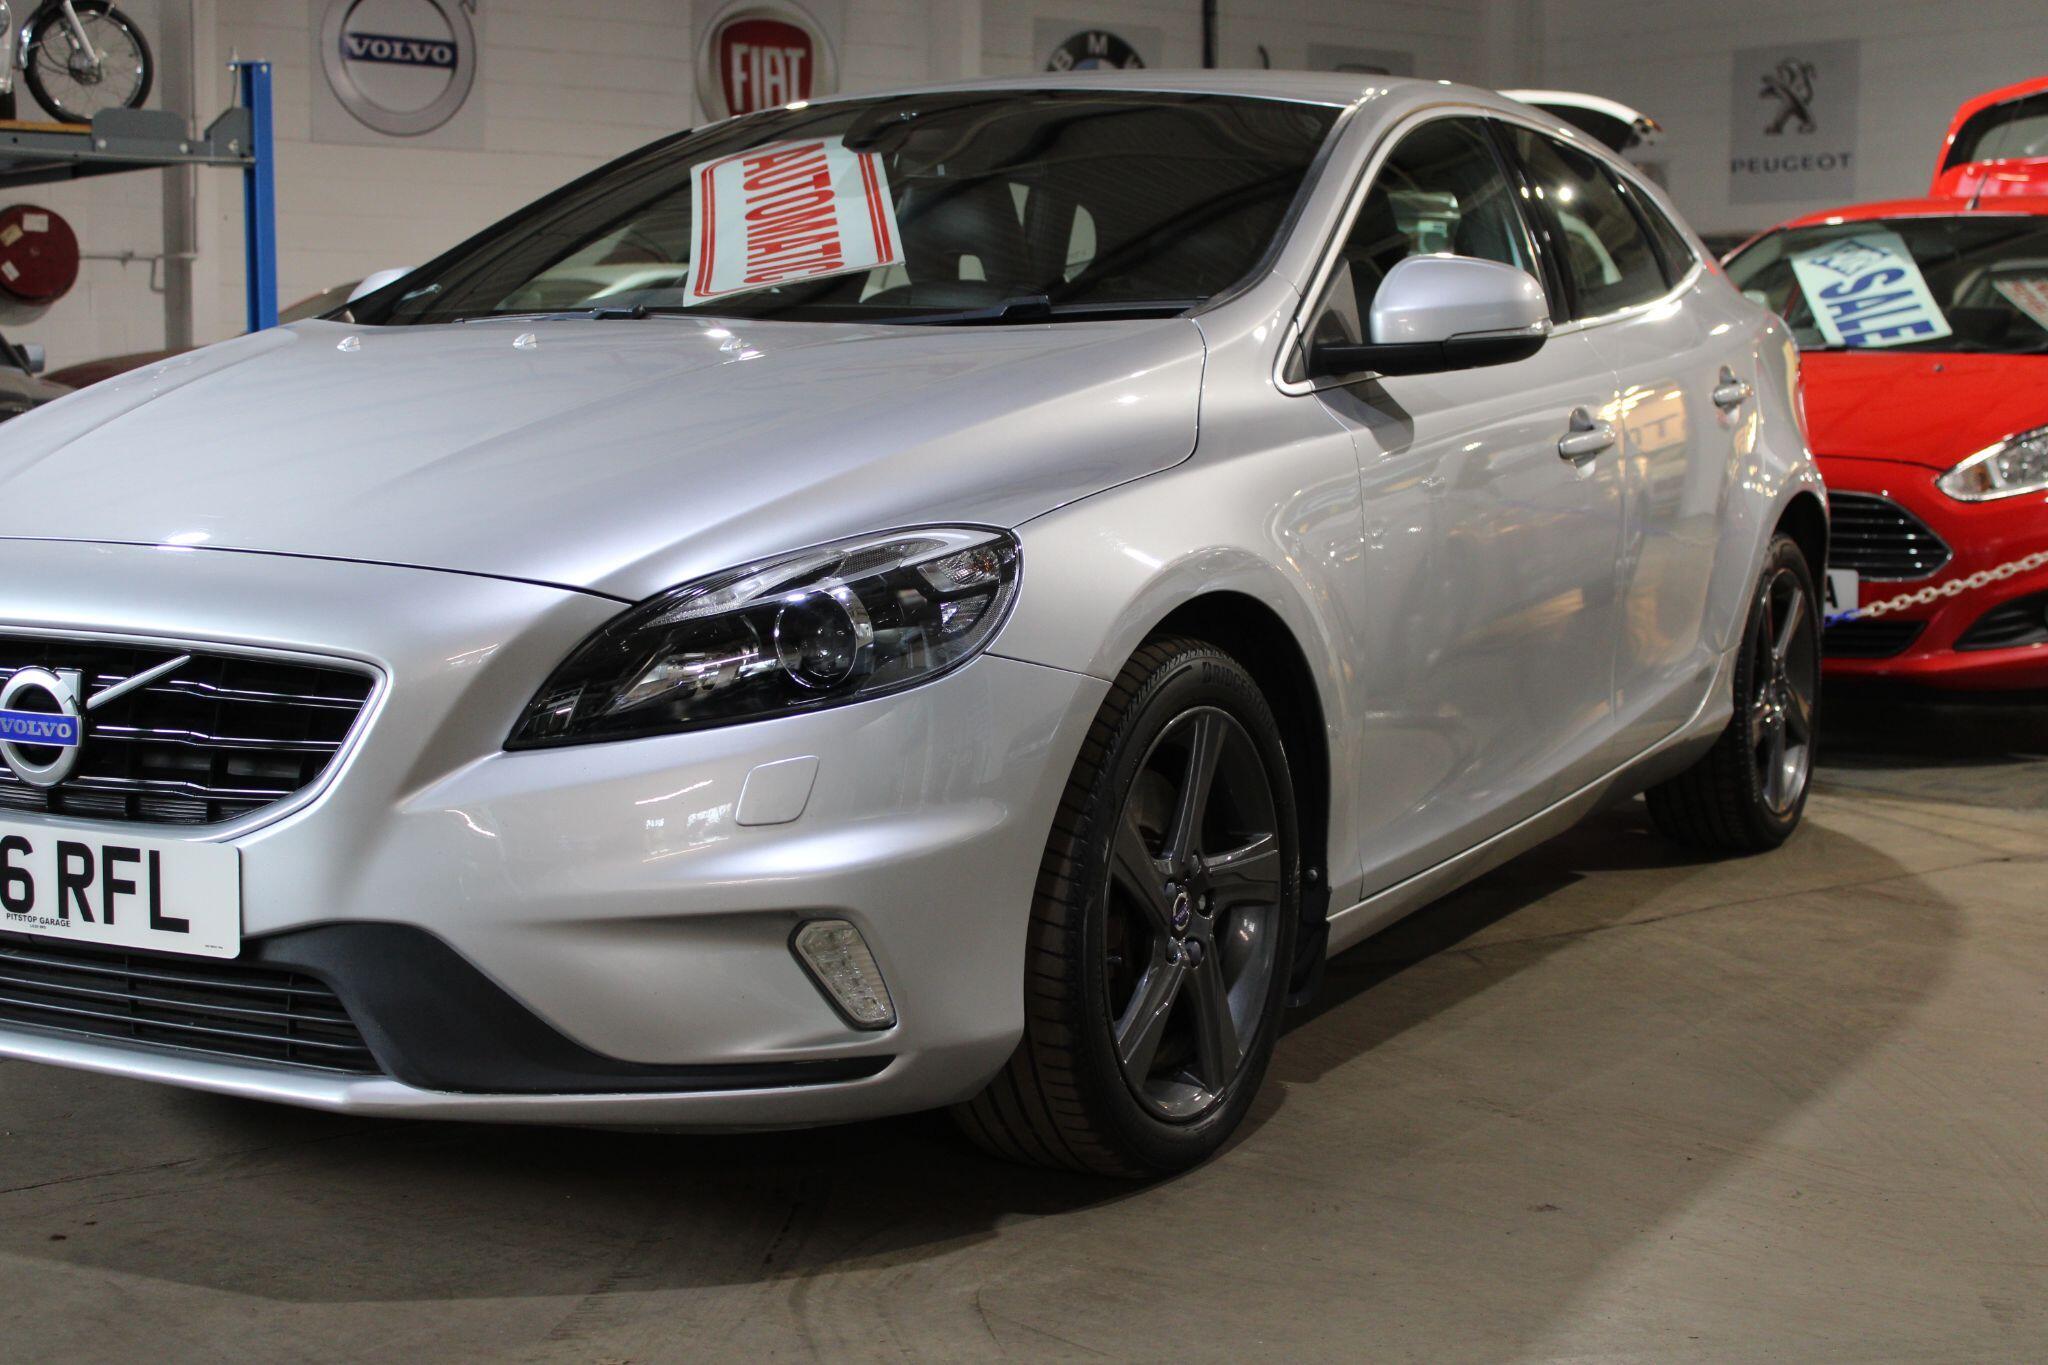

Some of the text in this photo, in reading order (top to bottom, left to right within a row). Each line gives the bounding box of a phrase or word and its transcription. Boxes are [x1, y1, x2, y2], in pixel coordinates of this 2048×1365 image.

[347, 36, 453, 64] VOLVO
[731, 42, 806, 113] FIAT
[1731, 152, 1853, 174] PEUGEOT
[743, 142, 844, 283] AUTOMATIC
[1819, 268, 1935, 345] SALE
[0, 717, 72, 738] VOLVO
[57, 840, 190, 933] RFL
[6, 912, 38, 923] PITSTOP
[39, 917, 72, 928] GARAGE
